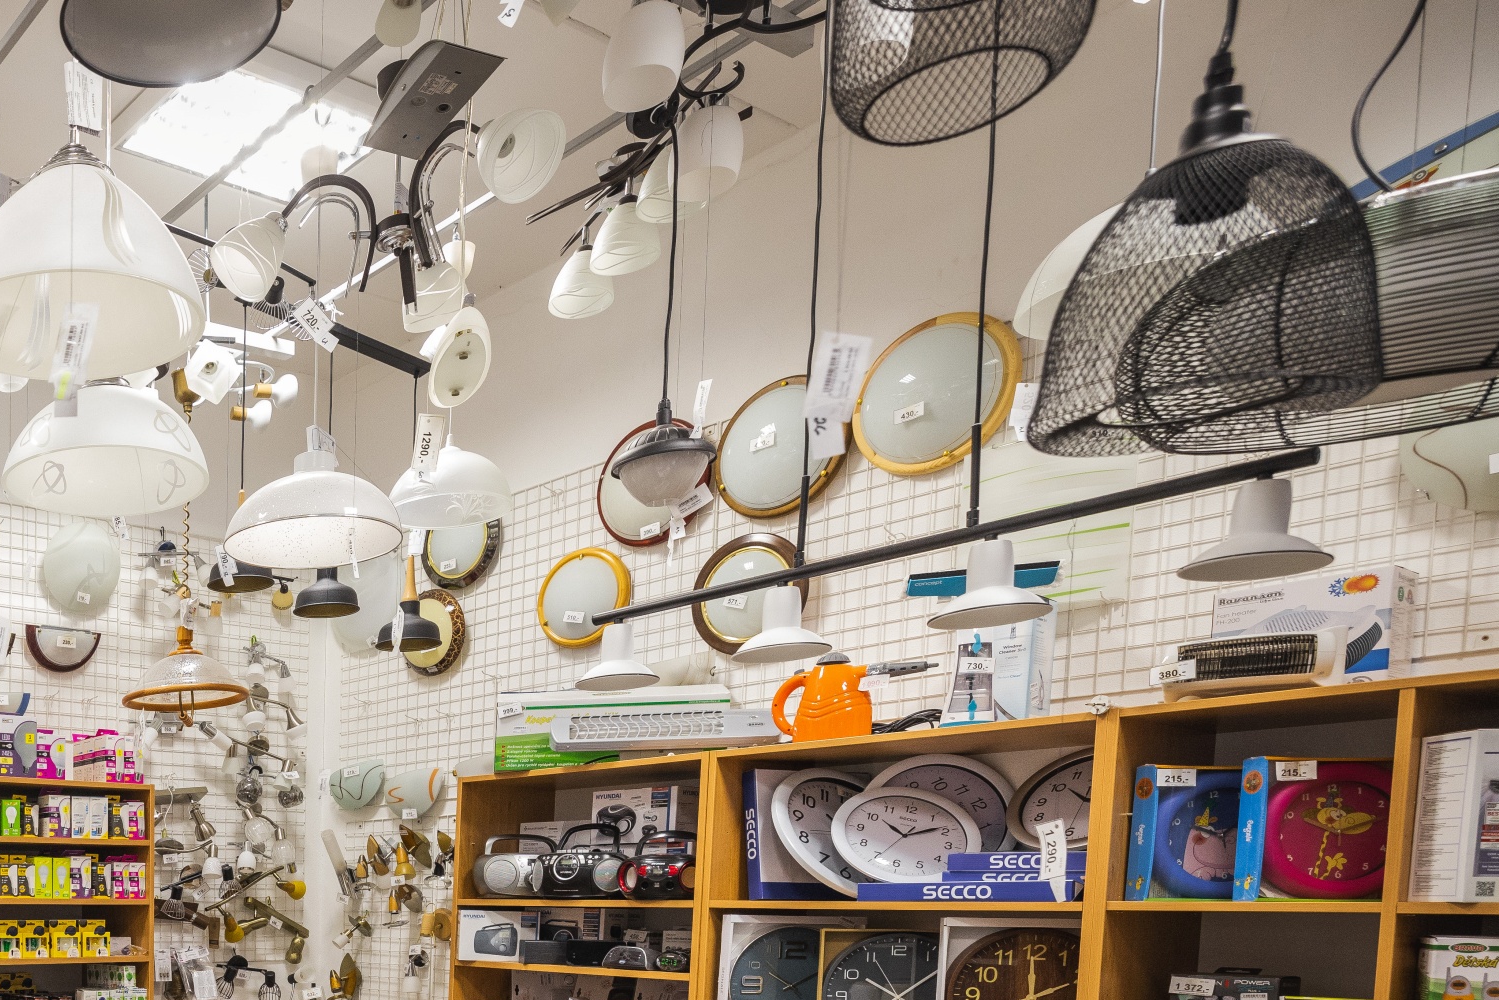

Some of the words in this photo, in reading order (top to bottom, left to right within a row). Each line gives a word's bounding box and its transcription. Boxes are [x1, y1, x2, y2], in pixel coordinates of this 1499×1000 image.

[301, 308, 321, 332] 720,-
[419, 429, 432, 463] 1290,-
[1216, 612, 1230, 620] Fan
[1231, 609, 1257, 617] heater
[1002, 641, 1023, 650] Window
[965, 661, 990, 671] 730,-
[1158, 666, 1188, 681] 380,-
[1163, 773, 1190, 784] 215,-
[1280, 767, 1308, 779] 215,-
[883, 804, 895, 814] 11
[905, 804, 918, 815] 12
[866, 812, 879, 822] 10
[930, 813, 937, 823] 1
[744, 807, 758, 860] SECCO
[856, 823, 865, 832] 9
[941, 827, 950, 837] 2
[1045, 829, 1055, 837] 1
[798, 830, 810, 844] 8
[859, 838, 868, 847] 8
[944, 841, 953, 851] 3
[933, 855, 942, 863] 4
[989, 854, 1041, 870] SECC
[1046, 840, 1058, 873] 290,-
[892, 859, 901, 868] 6
[915, 860, 924, 869] 5
[922, 884, 992, 900] SECCO
[891, 944, 908, 957] 12
[1022, 943, 1047, 962] 12
[865, 951, 876, 963] 11
[926, 951, 930, 963] 1
[994, 949, 1014, 966] 11
[1058, 949, 1068, 967] 1
[1452, 954, 1499, 969] Dětská
[843, 968, 860, 980] 10
[974, 965, 999, 983] 10
[1183, 983, 1210, 992] 372,-
